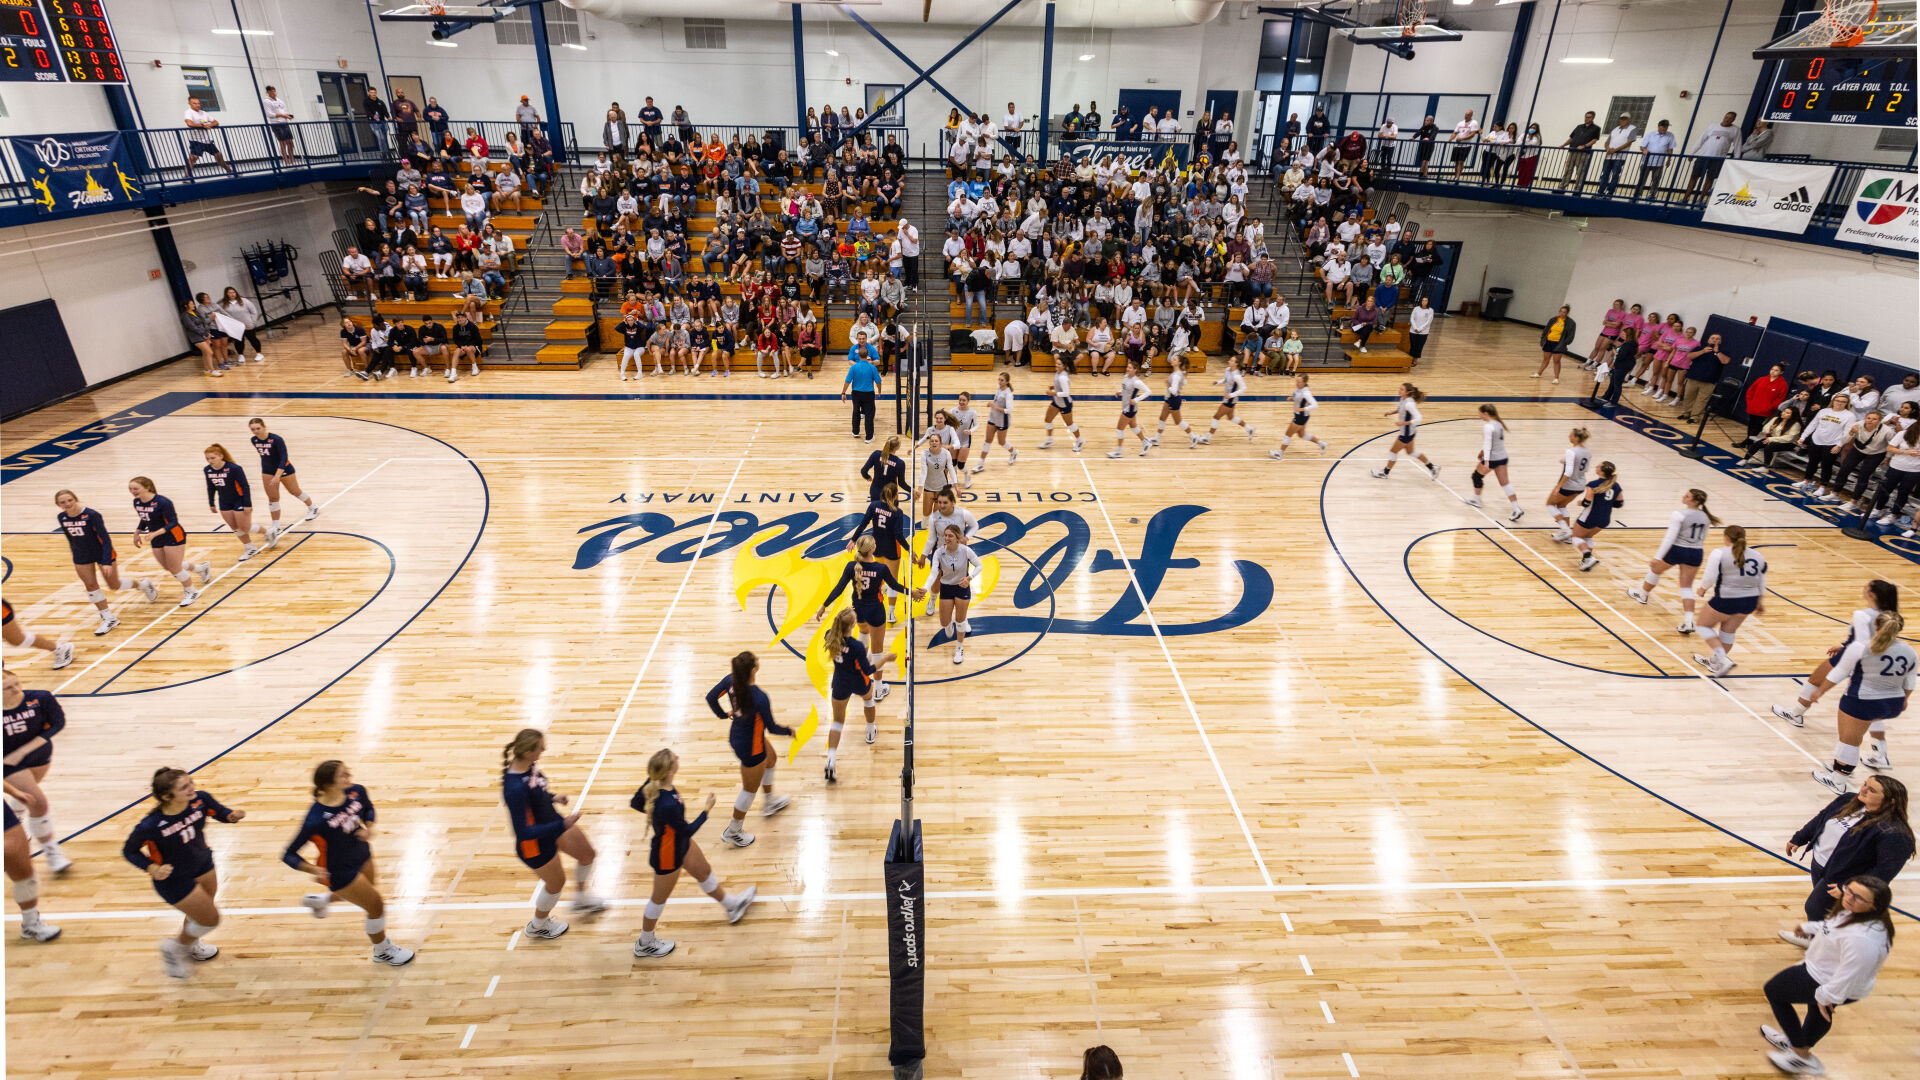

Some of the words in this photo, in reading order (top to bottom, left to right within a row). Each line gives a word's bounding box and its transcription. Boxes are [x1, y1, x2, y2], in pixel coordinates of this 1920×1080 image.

[53, 0, 64, 14] 5
[73, 2, 84, 16] 0
[92, 4, 103, 17] 0
[19, 10, 39, 36] 0
[59, 18, 70, 31] 6
[79, 19, 89, 33] 0
[98, 20, 108, 34] 0
[22, 38, 47, 48] FOULS
[61, 34, 75, 48] 10
[84, 34, 94, 48] 0
[103, 36, 113, 49] 0
[4, 47, 19, 68] 2
[35, 49, 50, 69] 0
[67, 51, 81, 65] 13
[90, 52, 100, 65] 0
[108, 52, 118, 66] 0
[73, 66, 87, 80] 15
[95, 67, 105, 80] 0
[114, 68, 123, 81] 0
[1807, 57, 1825, 79] 0
[35, 72, 59, 81] SCORE
[1780, 82, 1802, 91] FOULS
[1861, 83, 1881, 91] FOUL
[1782, 91, 1796, 109] 0
[1805, 91, 1820, 110] 2
[1866, 94, 1875, 110] 1
[1886, 93, 1903, 112] 2
[1770, 112, 1792, 121] SCORE
[1830, 114, 1857, 123] MATCH
[1714, 192, 1757, 207] Flames
[1773, 201, 1813, 213] adidas
[1845, 227, 1877, 238] Preferred
[1877, 232, 1909, 243] Provider
[0, 411, 155, 471] MARY
[1616, 414, 1863, 517] COLLEGE
[608, 492, 716, 503] MARY
[734, 492, 845, 503] SAINT
[957, 491, 1098, 503] COLLEG
[878, 514, 887, 529] 2
[67, 526, 85, 537] 20
[1691, 523, 1706, 539] 11
[950, 563, 955, 572] 1
[1739, 558, 1759, 577] 13
[861, 576, 871, 591] 3
[1880, 655, 1908, 676] 23
[4, 720, 28, 737] 15
[180, 825, 196, 844] 11
[906, 931, 918, 968] sports
